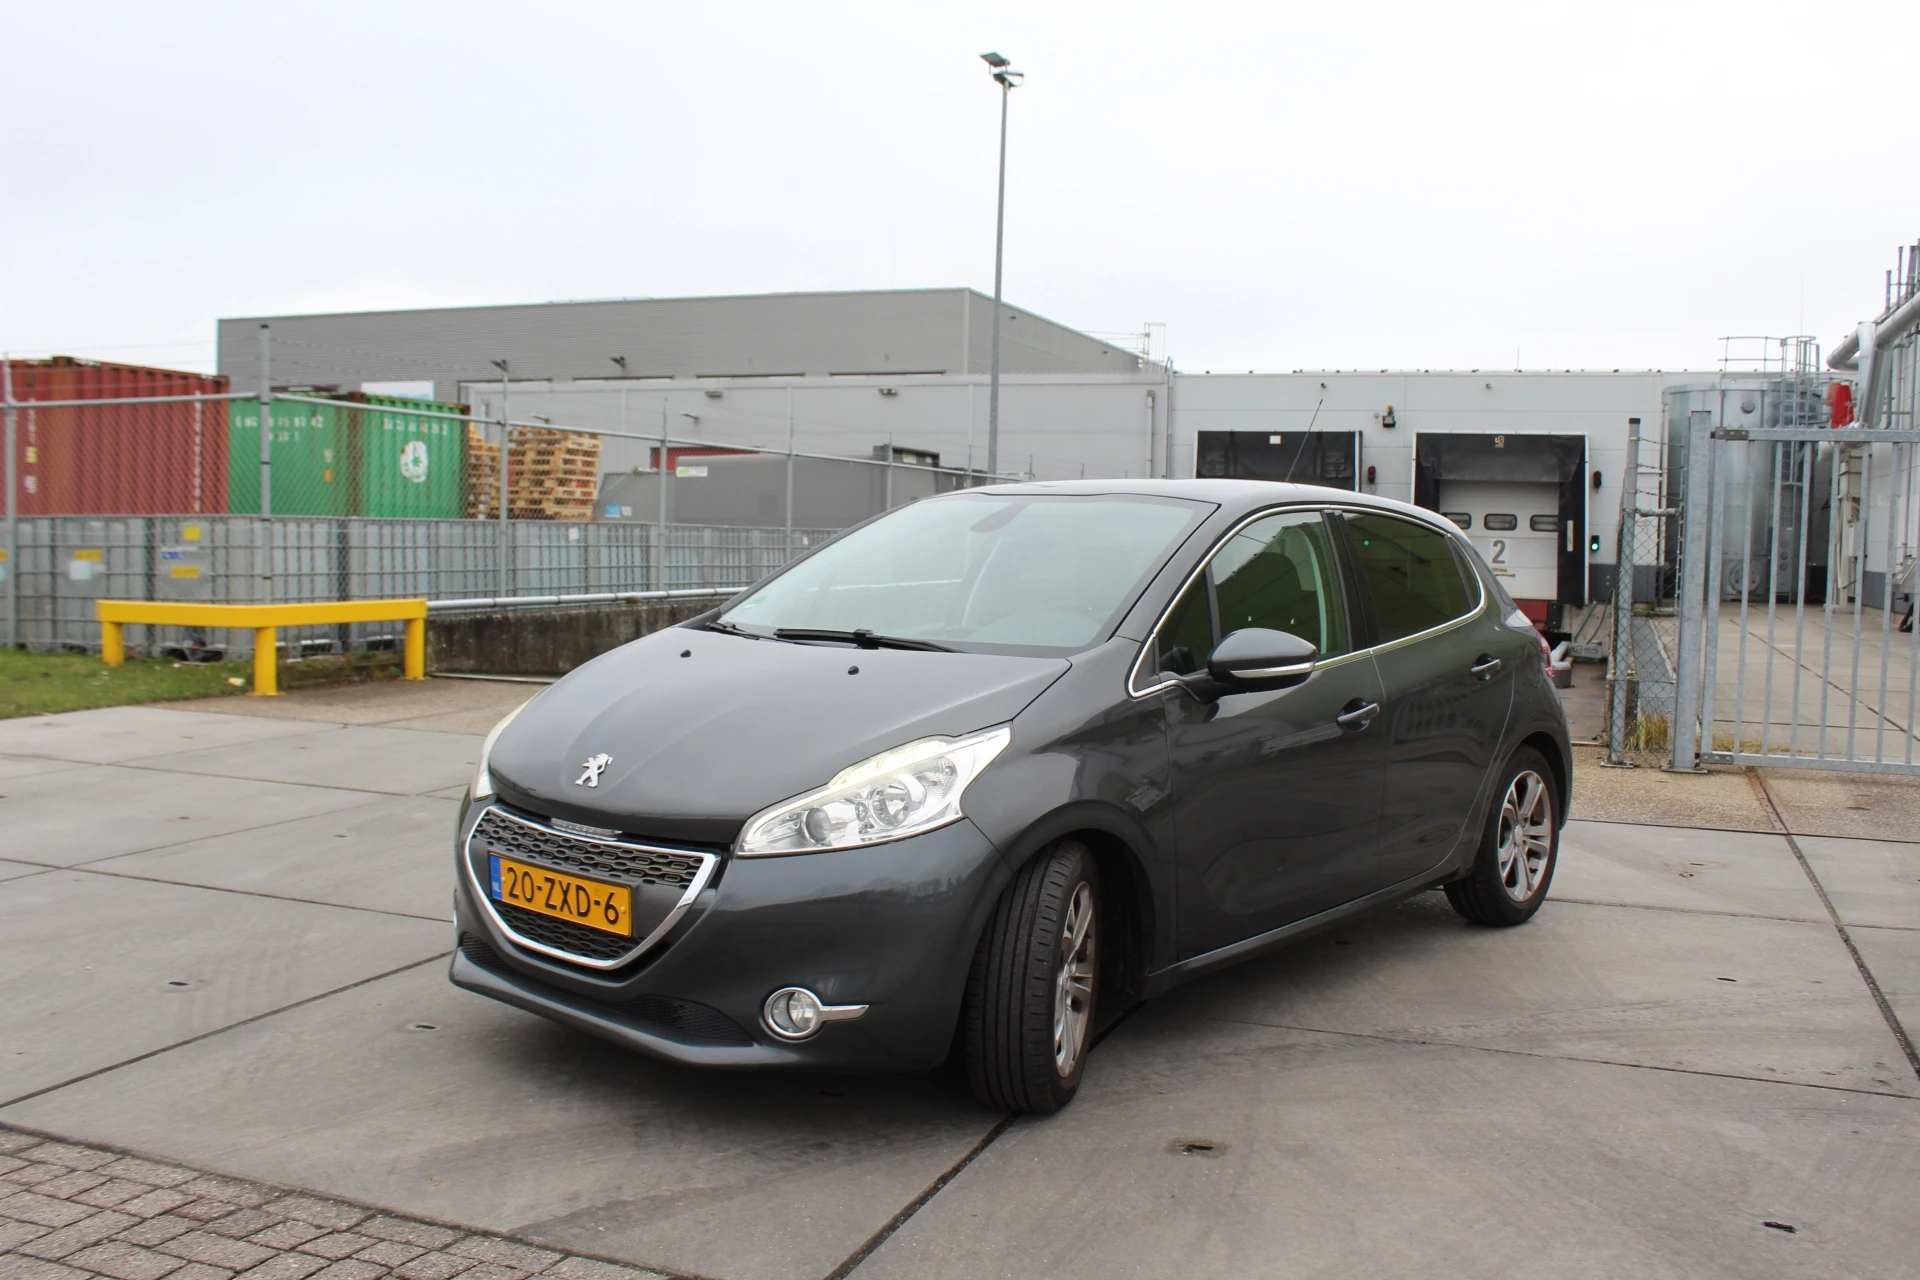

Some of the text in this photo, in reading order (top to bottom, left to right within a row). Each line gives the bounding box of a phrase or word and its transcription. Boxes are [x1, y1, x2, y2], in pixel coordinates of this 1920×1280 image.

[1492, 539, 1506, 565] 2
[492, 881, 502, 893] NL
[507, 866, 620, 925] 20-ZXD-6
